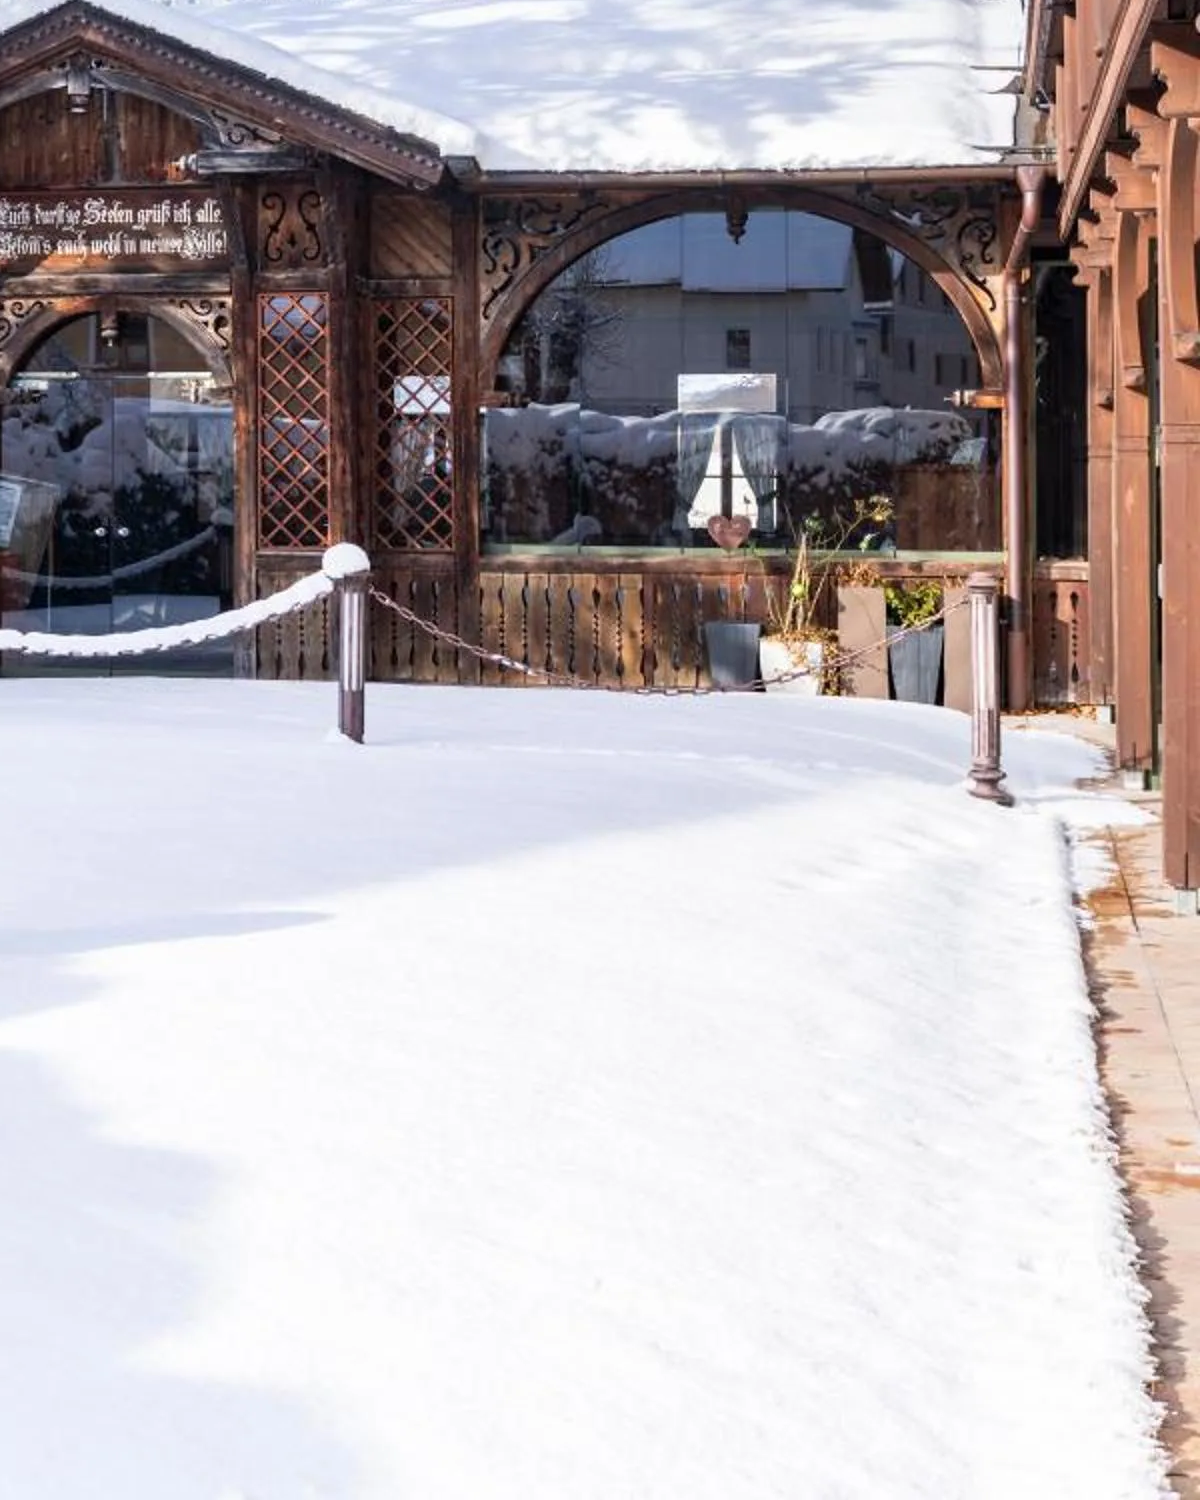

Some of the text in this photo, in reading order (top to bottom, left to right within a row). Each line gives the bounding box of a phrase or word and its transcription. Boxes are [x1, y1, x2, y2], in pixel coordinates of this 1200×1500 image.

[82, 197, 133, 225] Seelen
[131, 200, 171, 230] grüß
[173, 200, 191, 230] ich
[56, 231, 87, 264] euch
[91, 232, 122, 260] wohl
[123, 234, 136, 254] in
[139, 234, 182, 254] meiner
